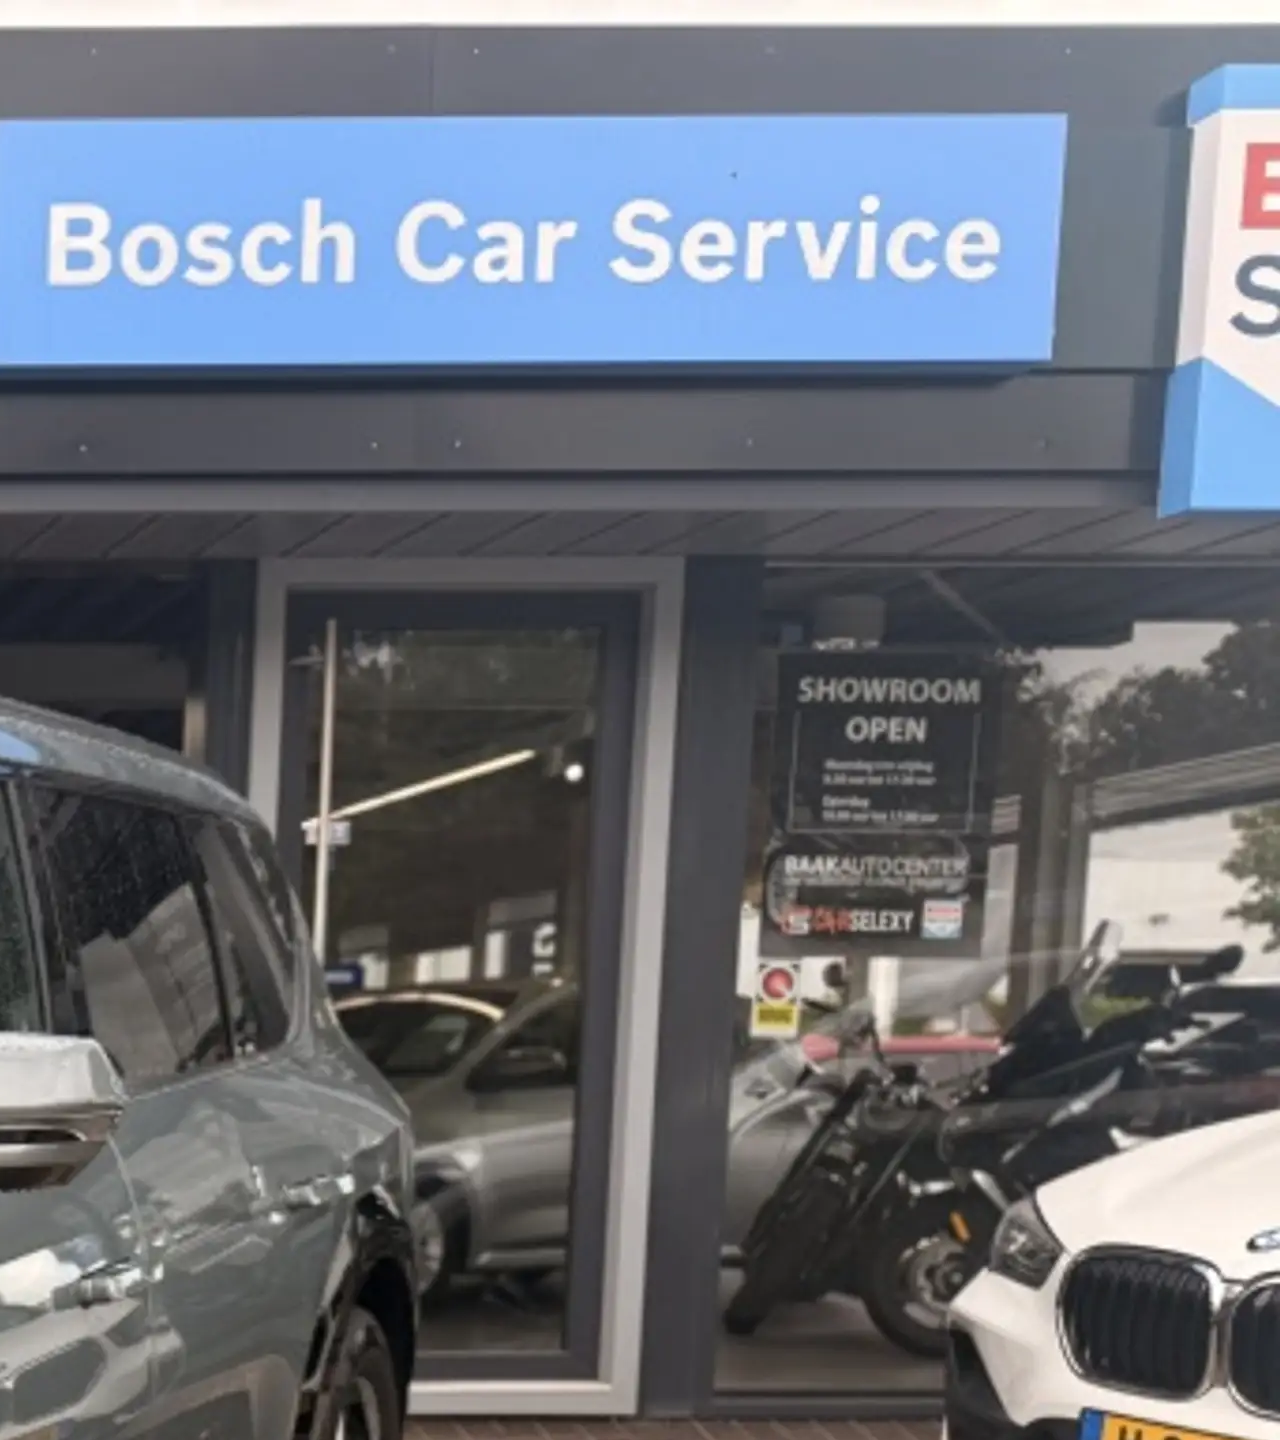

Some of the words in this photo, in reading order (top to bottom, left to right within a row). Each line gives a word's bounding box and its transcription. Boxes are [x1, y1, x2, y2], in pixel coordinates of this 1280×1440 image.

[45, 197, 356, 287] Bosch
[395, 199, 578, 285] Car
[608, 194, 1002, 286] Service
[797, 675, 981, 704] SHOWROOM
[845, 716, 928, 743] OPEN
